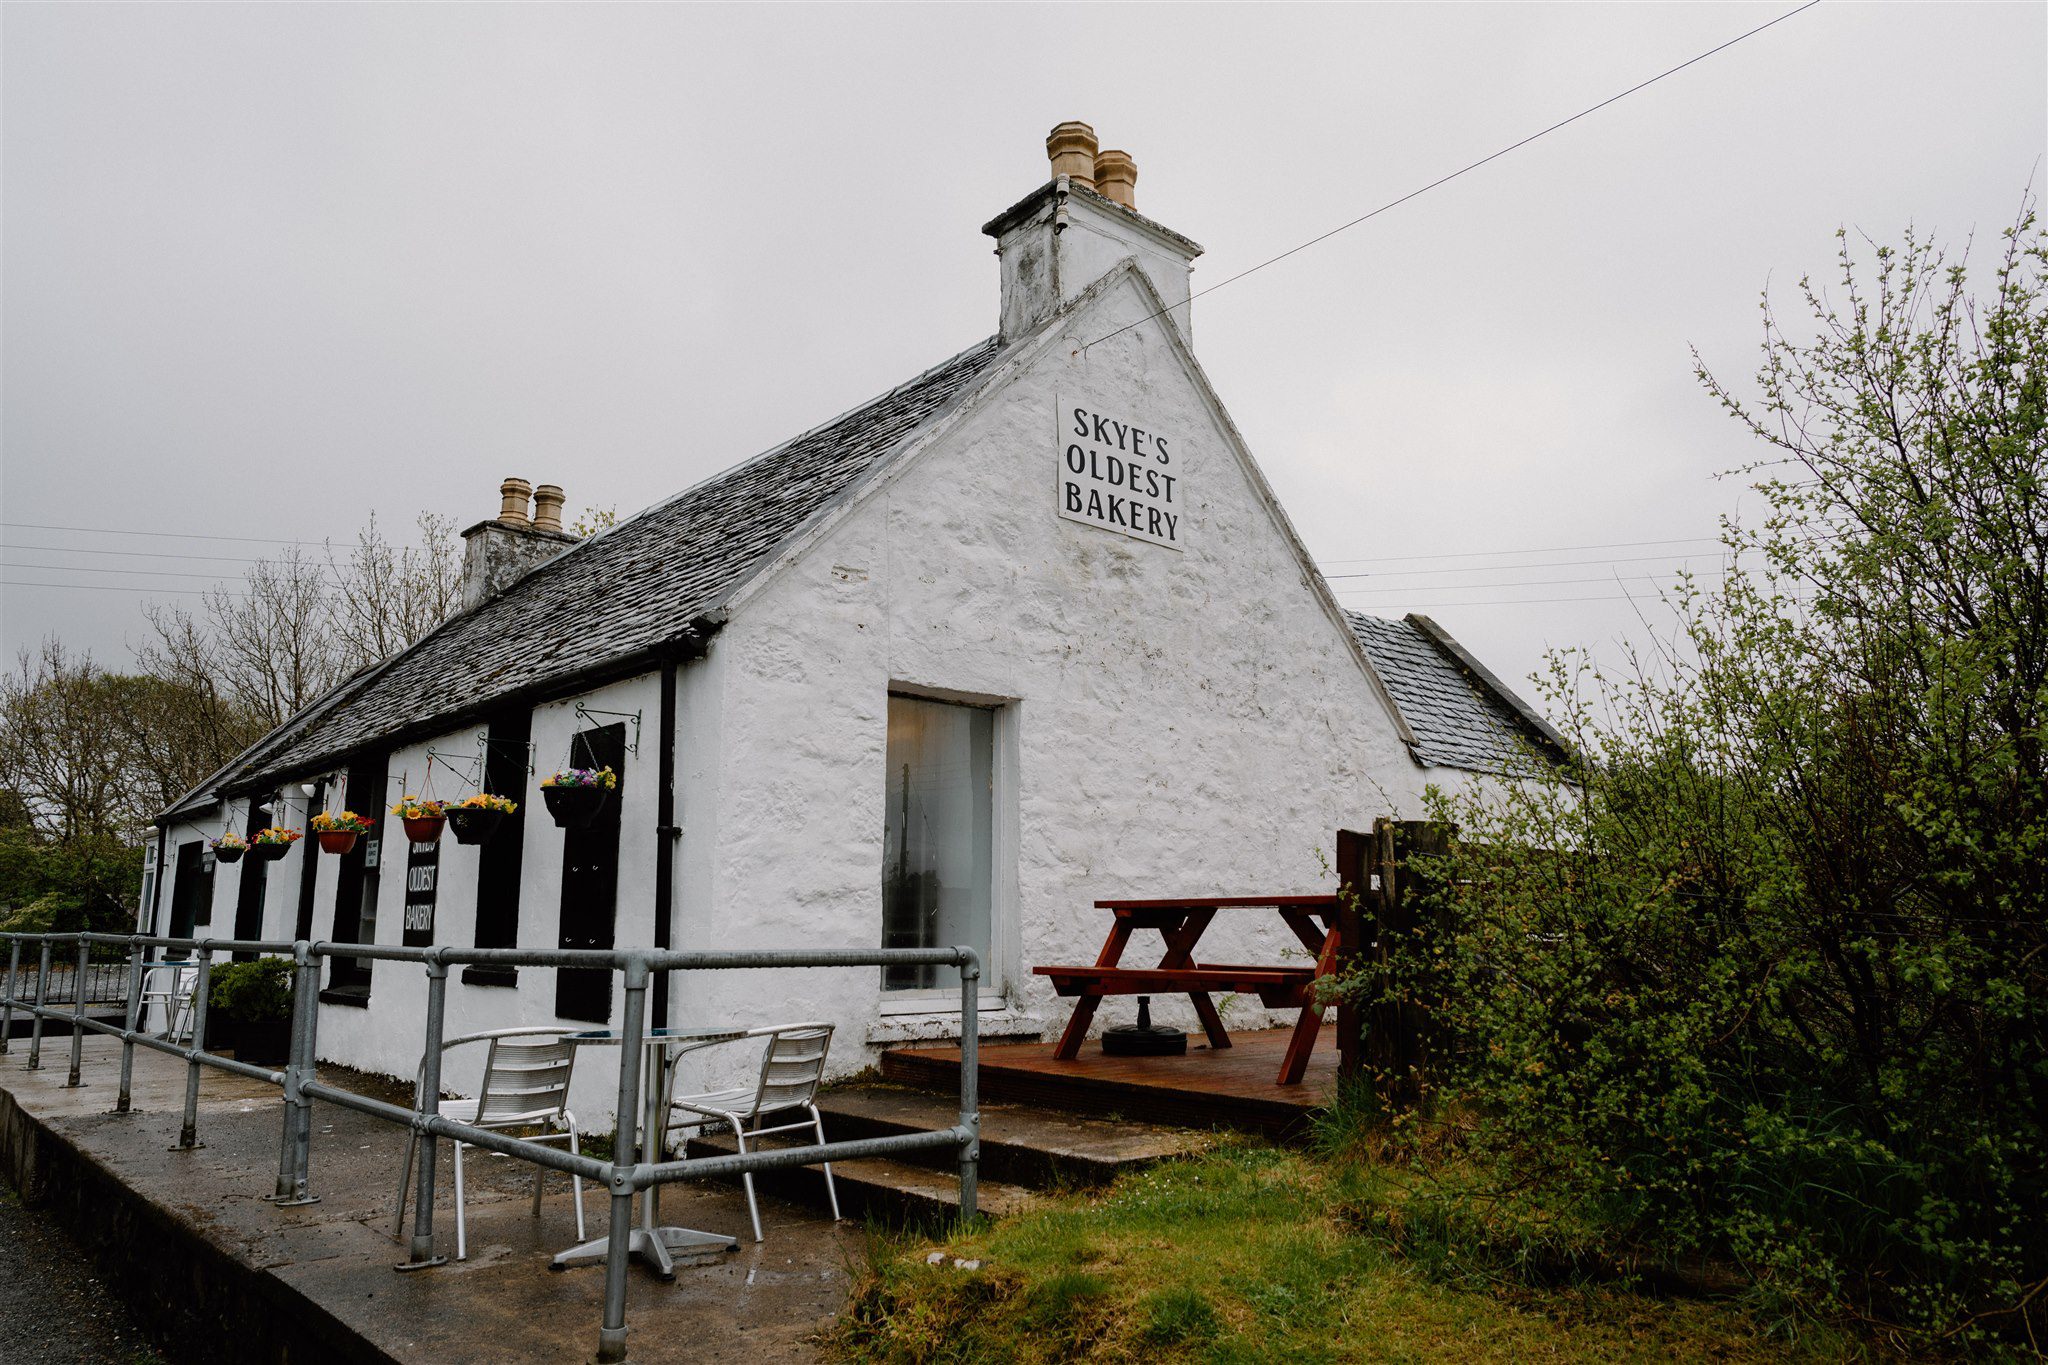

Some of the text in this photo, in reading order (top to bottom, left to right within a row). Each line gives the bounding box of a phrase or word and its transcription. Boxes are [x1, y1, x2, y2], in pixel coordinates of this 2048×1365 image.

[1073, 407, 1170, 465] SKYE'S
[1066, 443, 1177, 503] OLDEST
[1065, 481, 1178, 541] BAKERY
[408, 865, 436, 892] OLDEST
[405, 904, 433, 930] BAKERY
